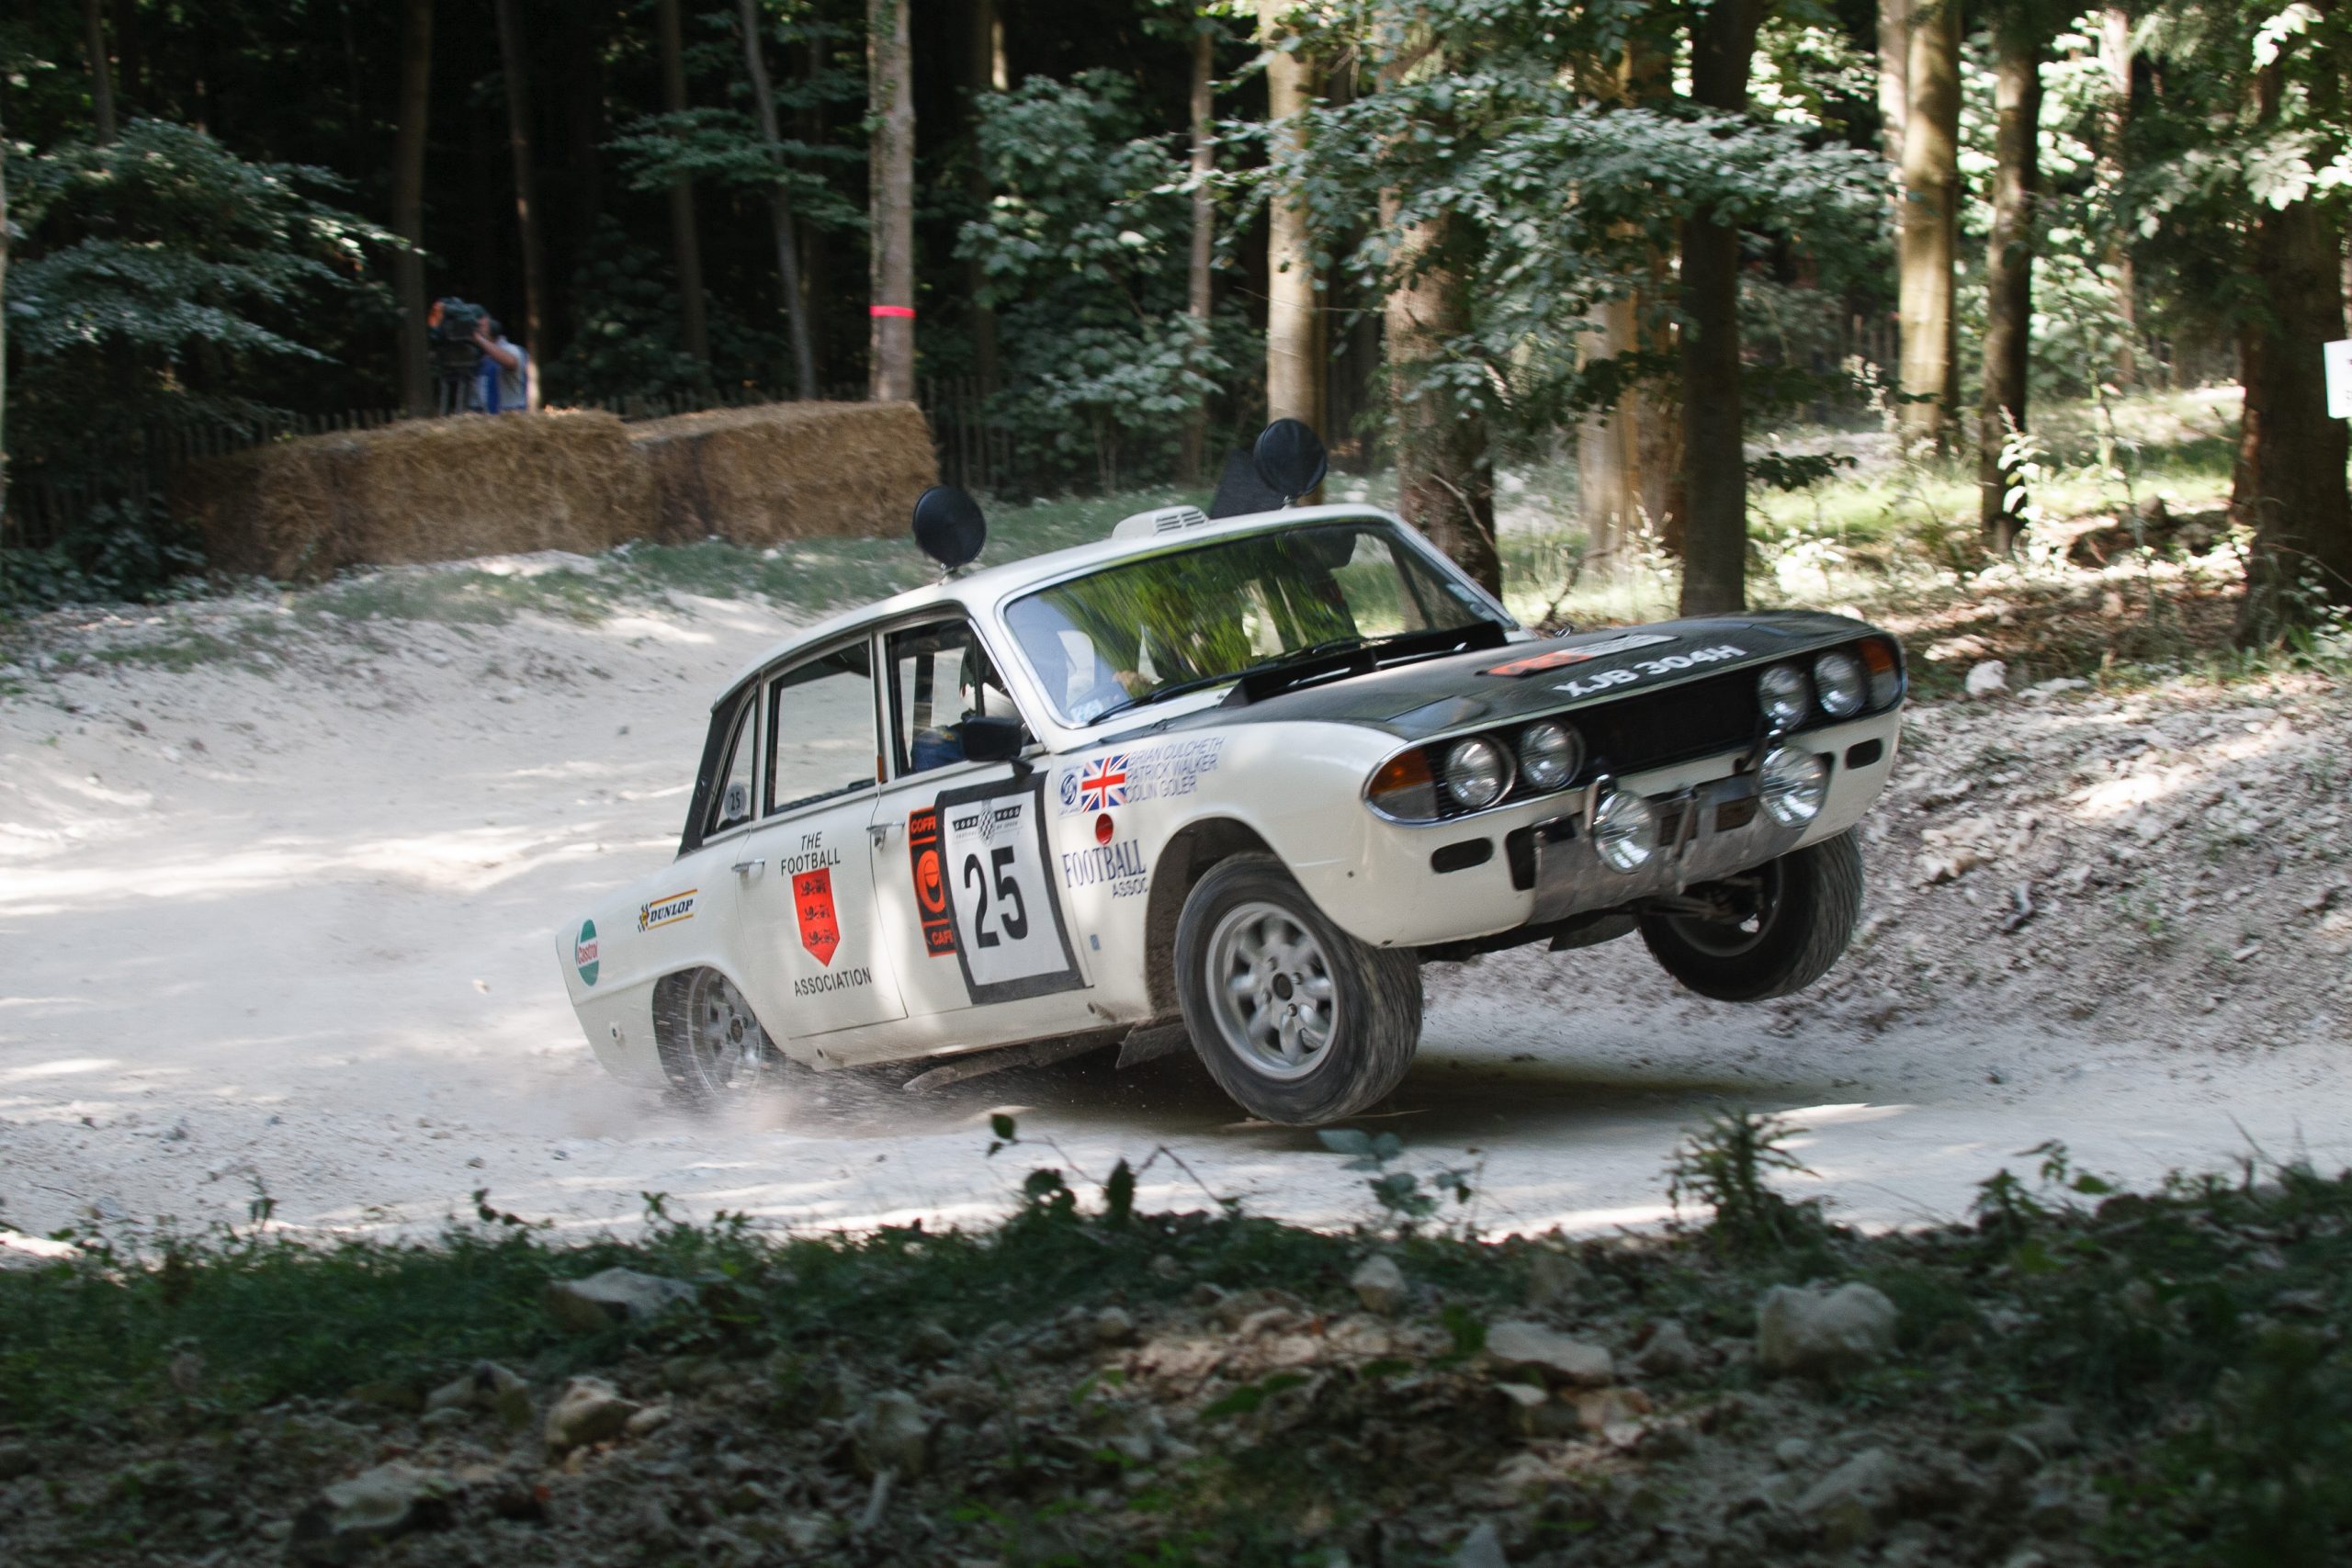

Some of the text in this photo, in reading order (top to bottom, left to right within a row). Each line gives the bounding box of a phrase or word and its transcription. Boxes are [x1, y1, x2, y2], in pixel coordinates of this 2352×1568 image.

[1554, 669, 1639, 698] XJB
[1635, 645, 1747, 675] 304H
[1126, 753, 1219, 783] PATRICK WALKER
[1129, 748, 1162, 766] BRIAN
[730, 791, 741, 811] 25
[1125, 780, 1159, 803] COLIN
[800, 830, 822, 851] THE
[781, 848, 841, 875] FOOTBALL
[1062, 839, 1147, 888] FOOTBALL
[965, 845, 1028, 949] 25
[650, 898, 694, 923] DUNLOP
[577, 941, 598, 964] Castrol
[794, 967, 873, 998] ASSOCIATION
